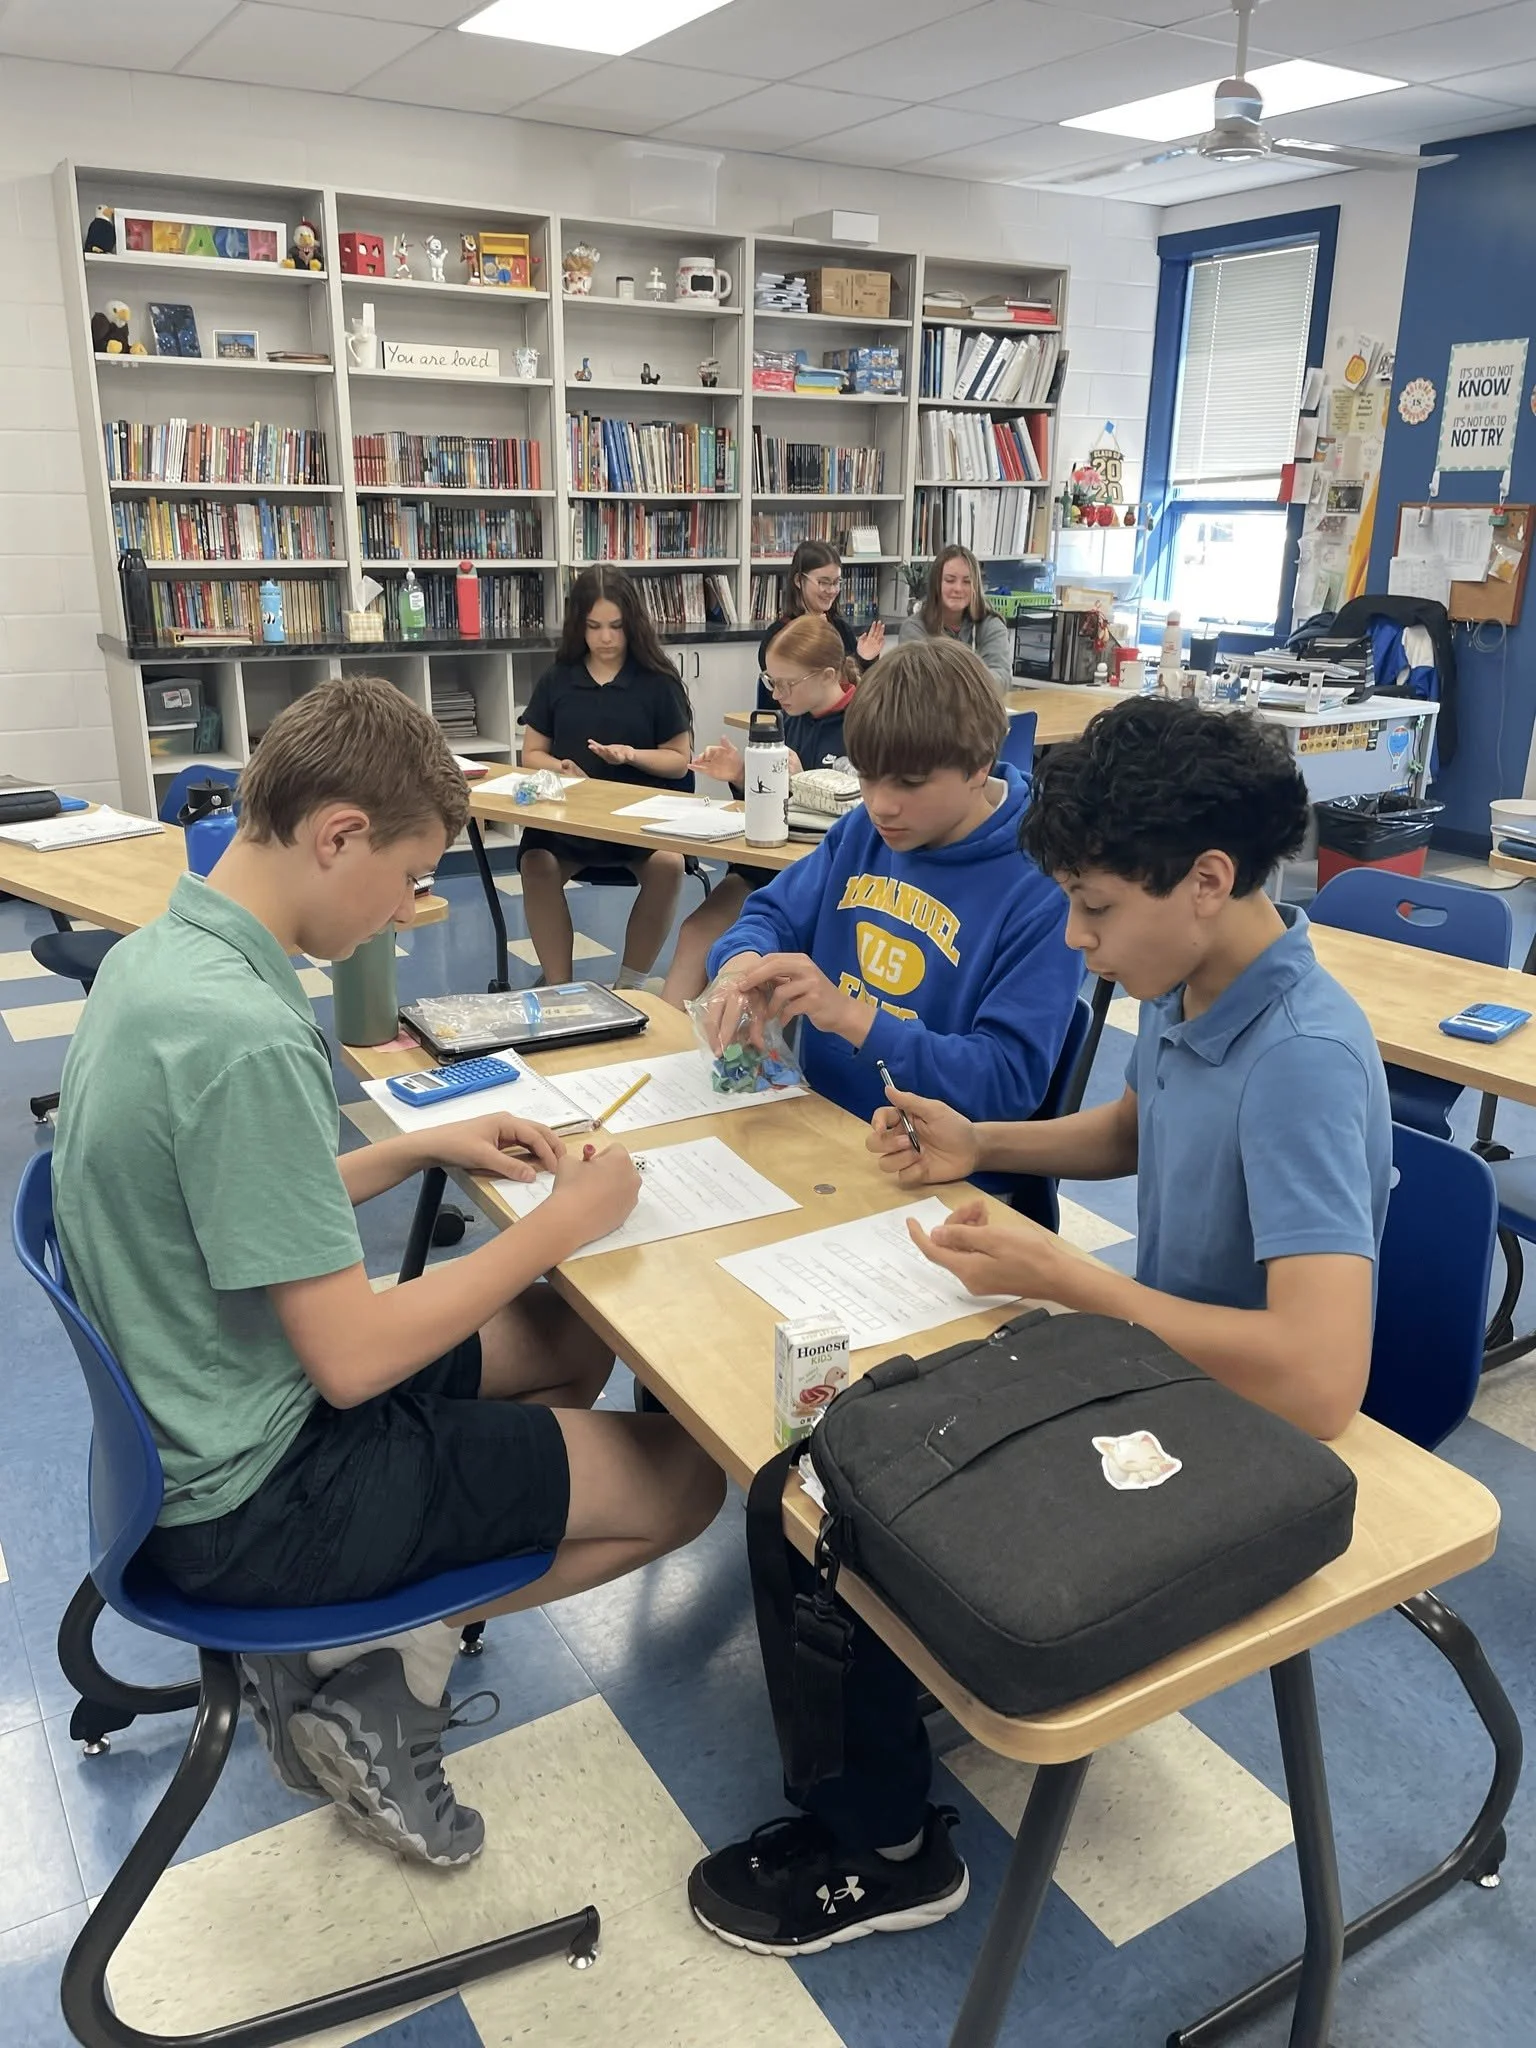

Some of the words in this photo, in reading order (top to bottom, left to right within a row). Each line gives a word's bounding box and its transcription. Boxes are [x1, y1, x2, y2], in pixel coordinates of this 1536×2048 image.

[388, 345, 414, 363] You
[420, 355, 447, 366] are
[451, 350, 491, 368] loved
[1460, 367, 1473, 379] IT'S
[1474, 366, 1485, 378] OK
[1486, 366, 1497, 377] TO
[1498, 364, 1515, 377] NOT
[1453, 416, 1466, 428] IT'S
[1467, 416, 1483, 427] NOT
[1484, 415, 1495, 427] OK
[1496, 415, 1507, 426] TO
[1451, 428, 1478, 447] NOT
[1091, 457, 1122, 481] 20
[1092, 481, 1124, 504] 20
[797, 1340, 846, 1359] Honest
